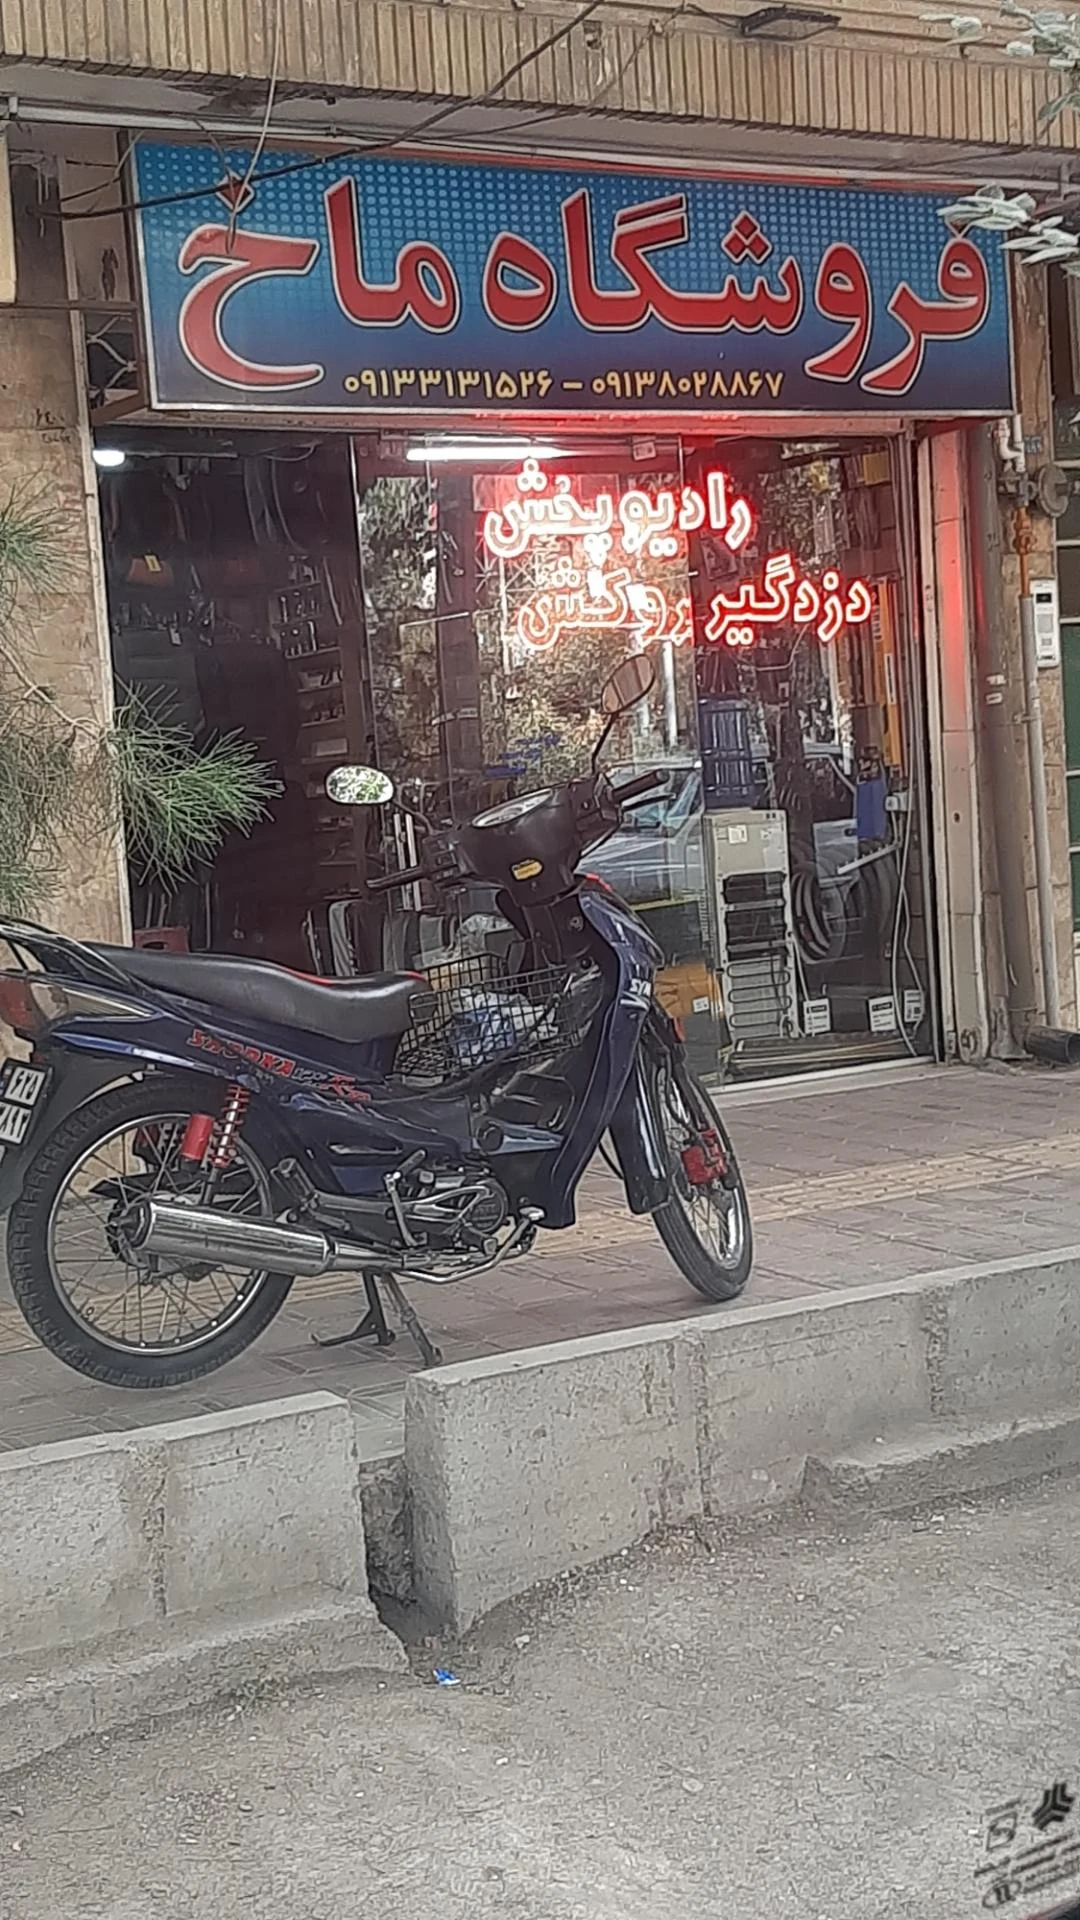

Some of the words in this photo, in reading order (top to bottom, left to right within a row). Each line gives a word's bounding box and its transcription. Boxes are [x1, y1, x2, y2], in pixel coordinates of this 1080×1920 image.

[178, 170, 460, 391] ماخ
[483, 187, 989, 396] فروشگاه
[344, 369, 553, 399] ۰۹۱۳۳۱۳۱۵۲۶
[592, 370, 784, 398] ۰۹۱۳۸۰۲۸۸۶۷
[484, 458, 613, 565] پخش
[619, 472, 752, 556] رادیو
[705, 554, 871, 646] دزدگیر
